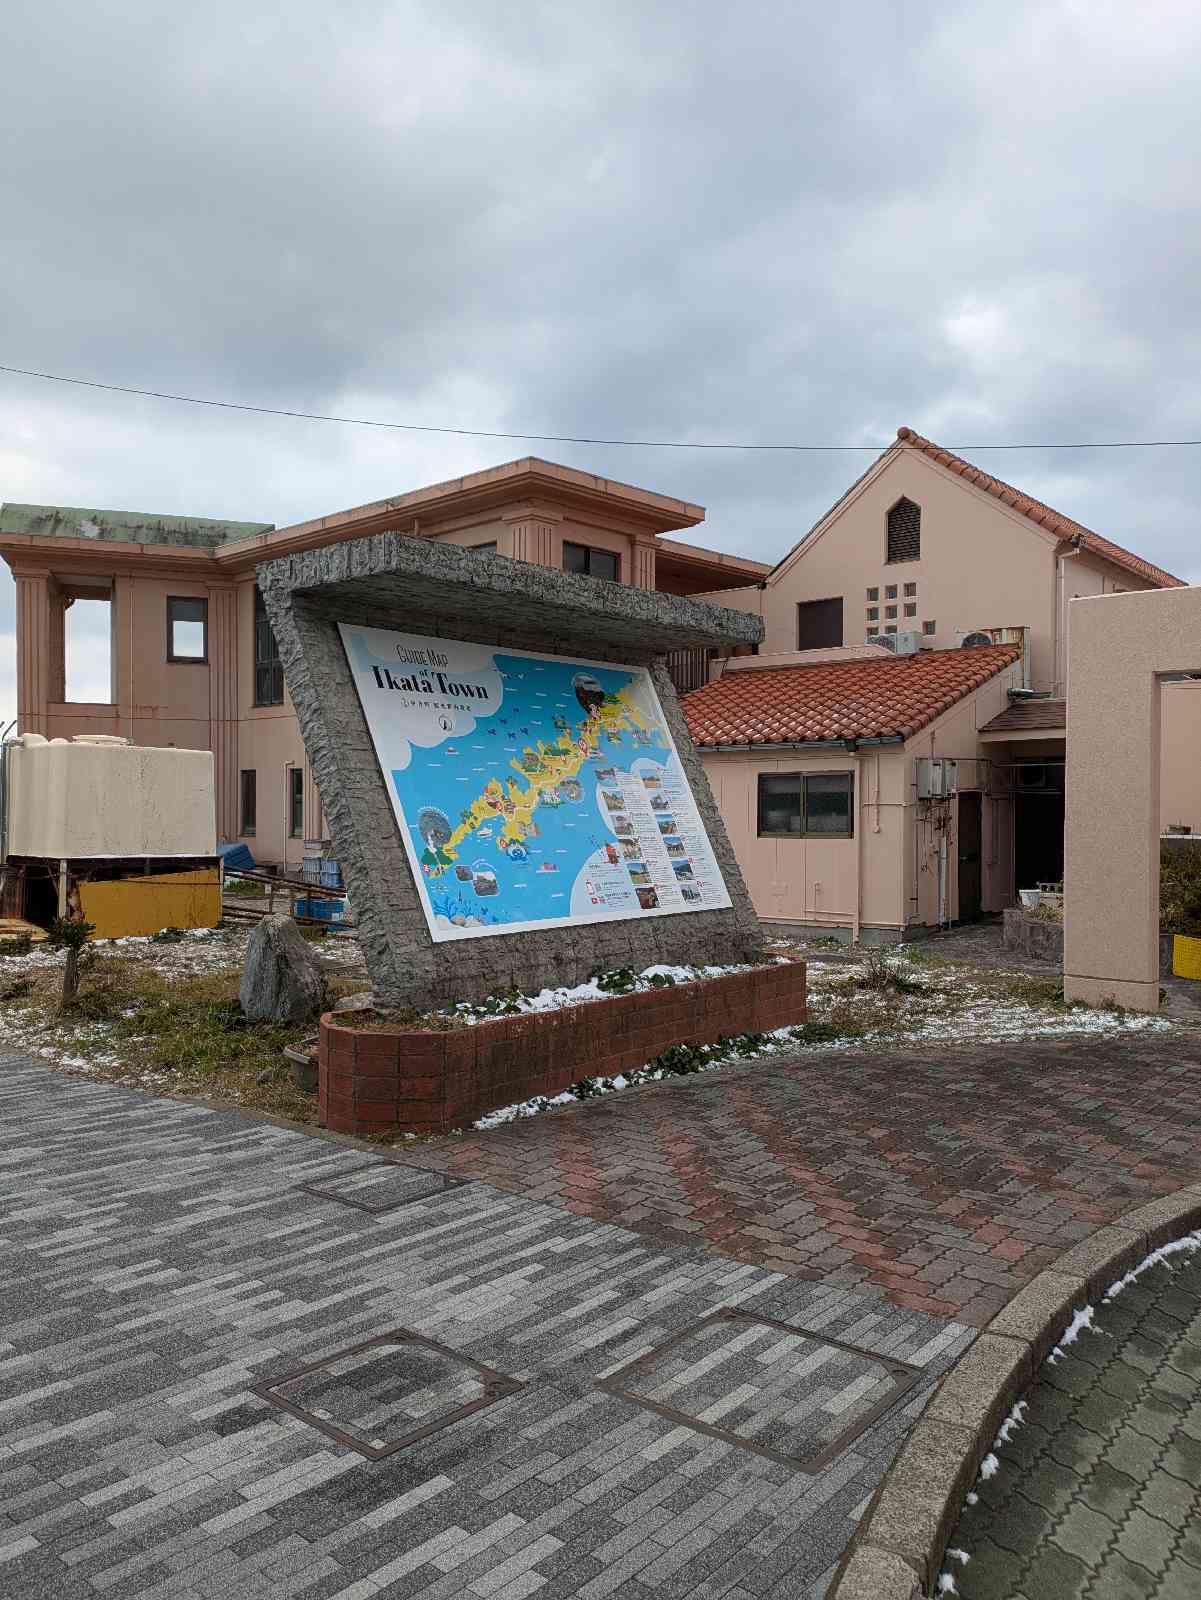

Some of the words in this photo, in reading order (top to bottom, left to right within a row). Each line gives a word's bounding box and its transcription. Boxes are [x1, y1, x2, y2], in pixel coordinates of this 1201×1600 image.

[397, 644, 426, 666] GUIDE
[426, 648, 448, 668] MAP
[372, 665, 434, 694] Ikata
[431, 672, 489, 699] Town
